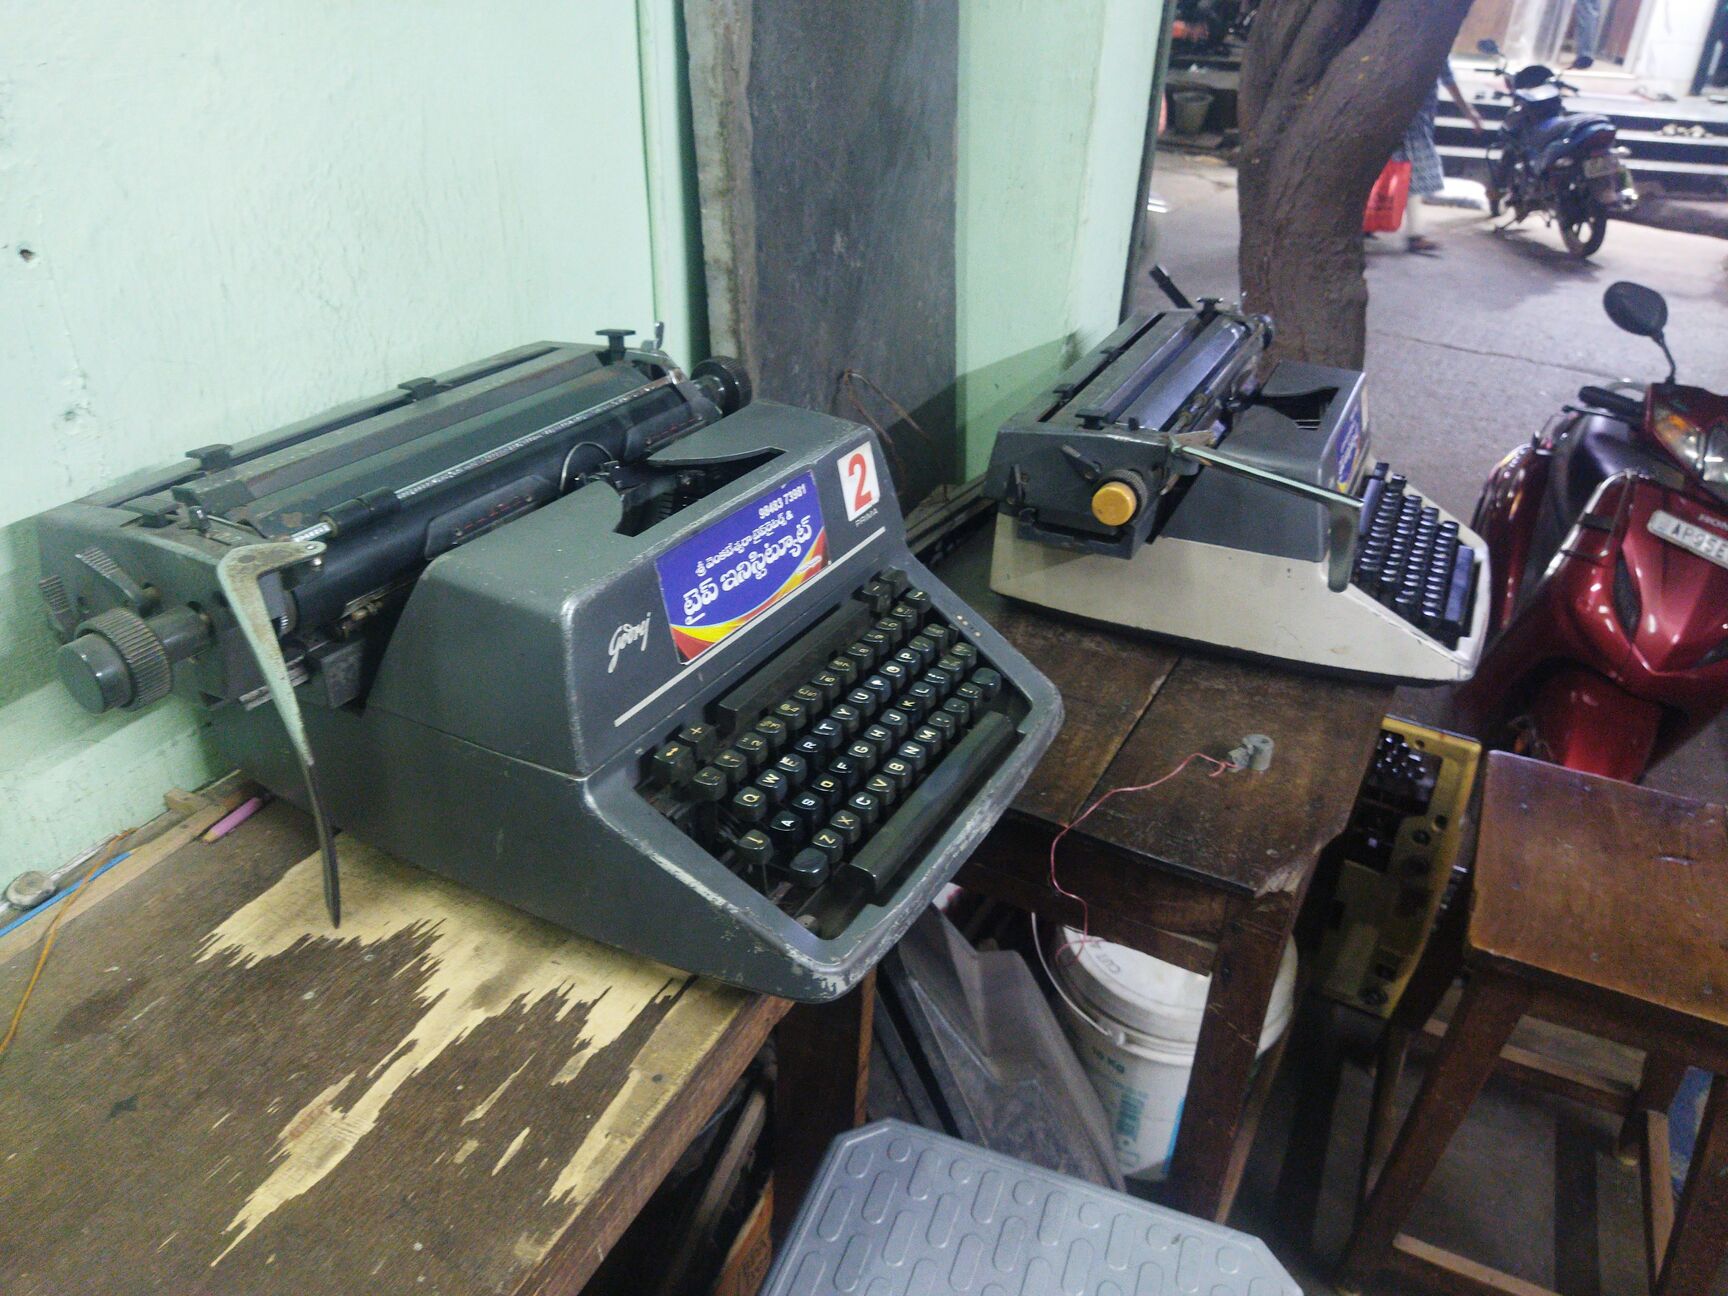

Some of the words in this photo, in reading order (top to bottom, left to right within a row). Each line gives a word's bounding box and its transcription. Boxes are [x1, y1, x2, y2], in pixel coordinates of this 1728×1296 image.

[848, 453, 873, 512] 2
[683, 577, 719, 626] టైప్
[695, 561, 706, 577] శ్రీ
[743, 794, 760, 803] Q
[762, 773, 780, 784] W
[803, 741, 817, 750] R
[819, 723, 834, 732] T
[836, 708, 851, 716] Y
[854, 692, 869, 701] U
[900, 652, 913, 660] P
[781, 819, 795, 828] A
[801, 798, 816, 807] S
[836, 762, 848, 770] F
[853, 745, 869, 754] G
[870, 729, 885, 738] H
[888, 713, 902, 722] J
[820, 834, 836, 844] Z
[836, 815, 854, 825] X
[855, 796, 871, 806] C
[872, 778, 888, 788] V
[888, 762, 905, 771] B
[904, 745, 920, 755] N
[919, 730, 936, 740] M
